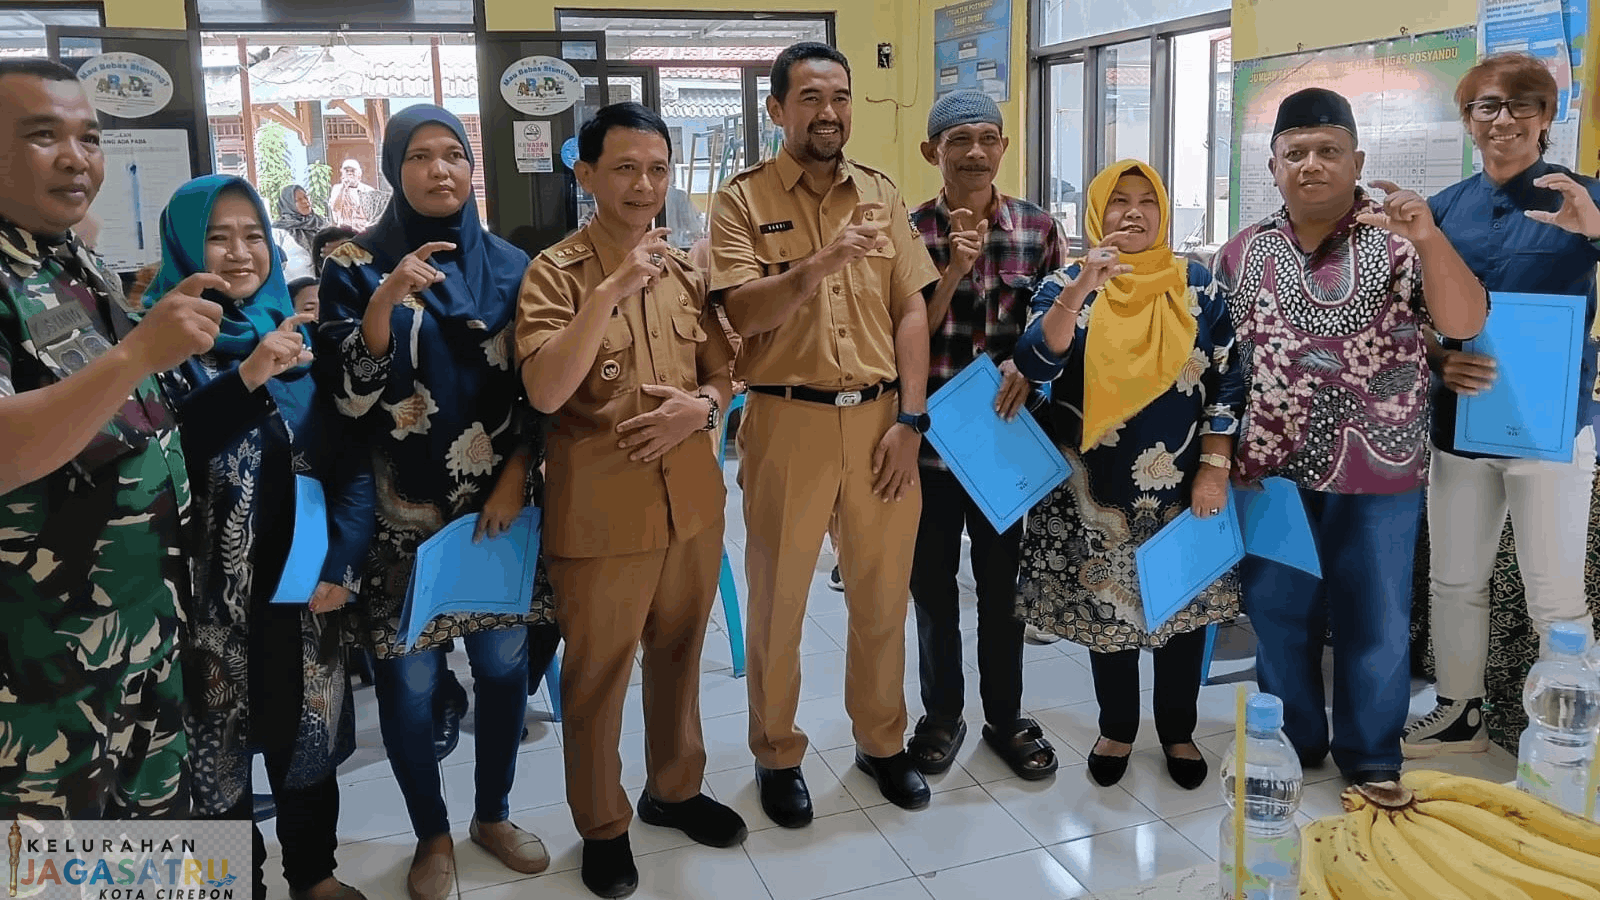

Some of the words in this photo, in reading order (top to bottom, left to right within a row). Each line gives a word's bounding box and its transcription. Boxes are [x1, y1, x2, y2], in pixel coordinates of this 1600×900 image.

[1409, 46, 1459, 65] POSYANDU
[503, 74, 518, 87] Mau
[518, 65, 542, 75] Bebas
[544, 65, 579, 84] Stunting?
